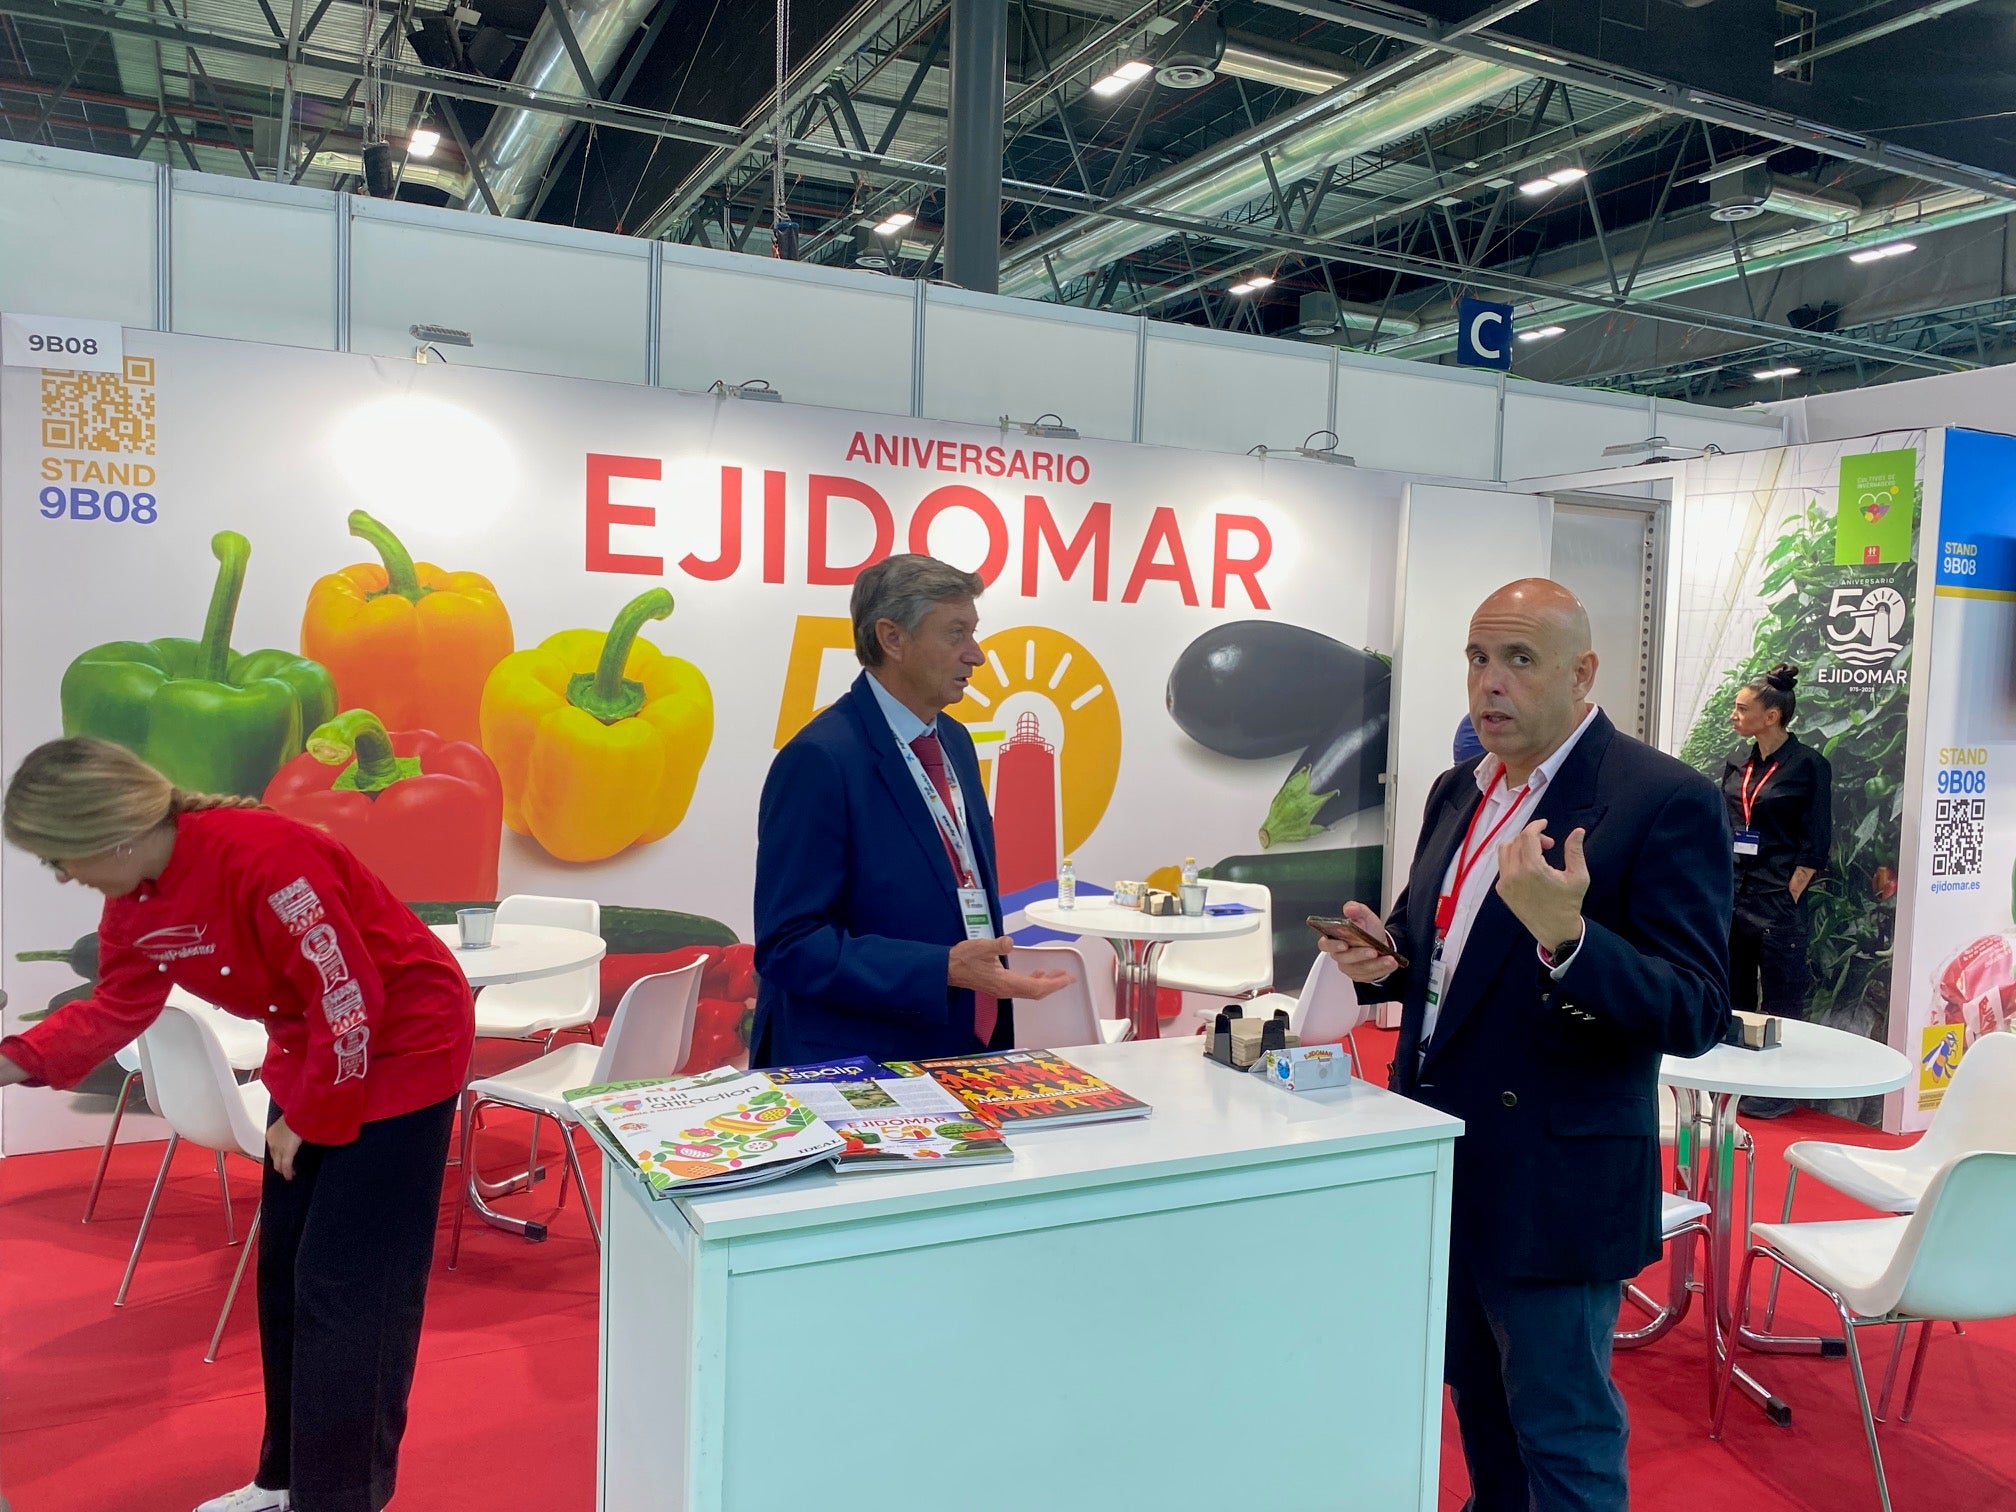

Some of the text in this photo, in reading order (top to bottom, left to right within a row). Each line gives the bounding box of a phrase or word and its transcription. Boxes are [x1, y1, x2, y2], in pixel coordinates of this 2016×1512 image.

[28, 334, 98, 355] 9B08
[1470, 311, 1503, 359] C
[845, 430, 1091, 486] ANIVERSARIO
[40, 457, 156, 487] STAND
[39, 486, 158, 524] 9B08
[585, 452, 1273, 610] EJIDOMAR
[1945, 542, 1978, 556] STAND
[1943, 557, 1977, 576] 9B08
[1841, 577, 1895, 586] ANIVERSARIO
[1818, 668, 1908, 684] EJIDOMAR
[1939, 747, 1988, 766] STAND
[1937, 770, 1986, 794] 9B08
[1931, 881, 1981, 894] ejidomar.es
[645, 1092, 688, 1104] fruit
[651, 1085, 760, 1109] attraction
[978, 1085, 1109, 1104] New connections
[847, 1116, 948, 1129] EJIDOMAR
[799, 1138, 842, 1154] IDEAL
